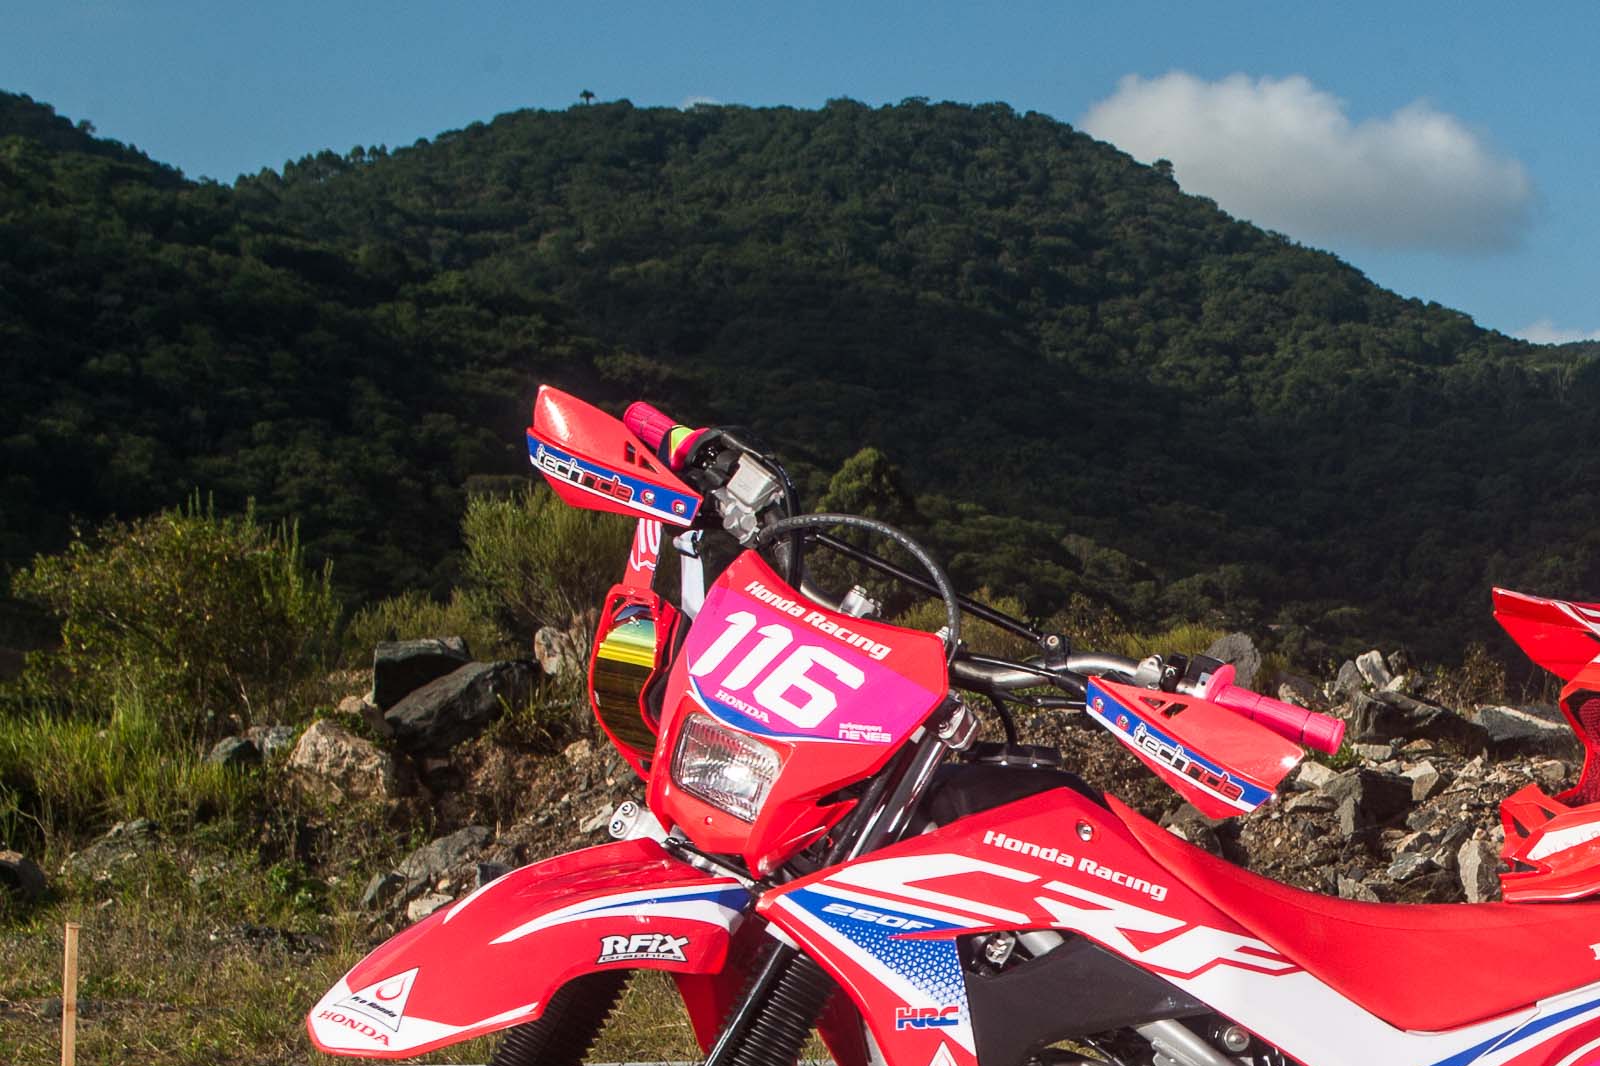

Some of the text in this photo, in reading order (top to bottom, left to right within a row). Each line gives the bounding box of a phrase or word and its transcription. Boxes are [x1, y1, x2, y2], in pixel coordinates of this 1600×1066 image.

[536, 443, 635, 503] techride
[744, 580, 892, 661] Honda Racing
[689, 610, 865, 729] 116
[715, 689, 770, 723] HONDA
[1133, 723, 1244, 802] techride
[982, 830, 1169, 902] Honda Racing
[821, 902, 935, 932] 250F
[317, 1009, 390, 1047] HONDA
[896, 1005, 960, 1031] HRC
